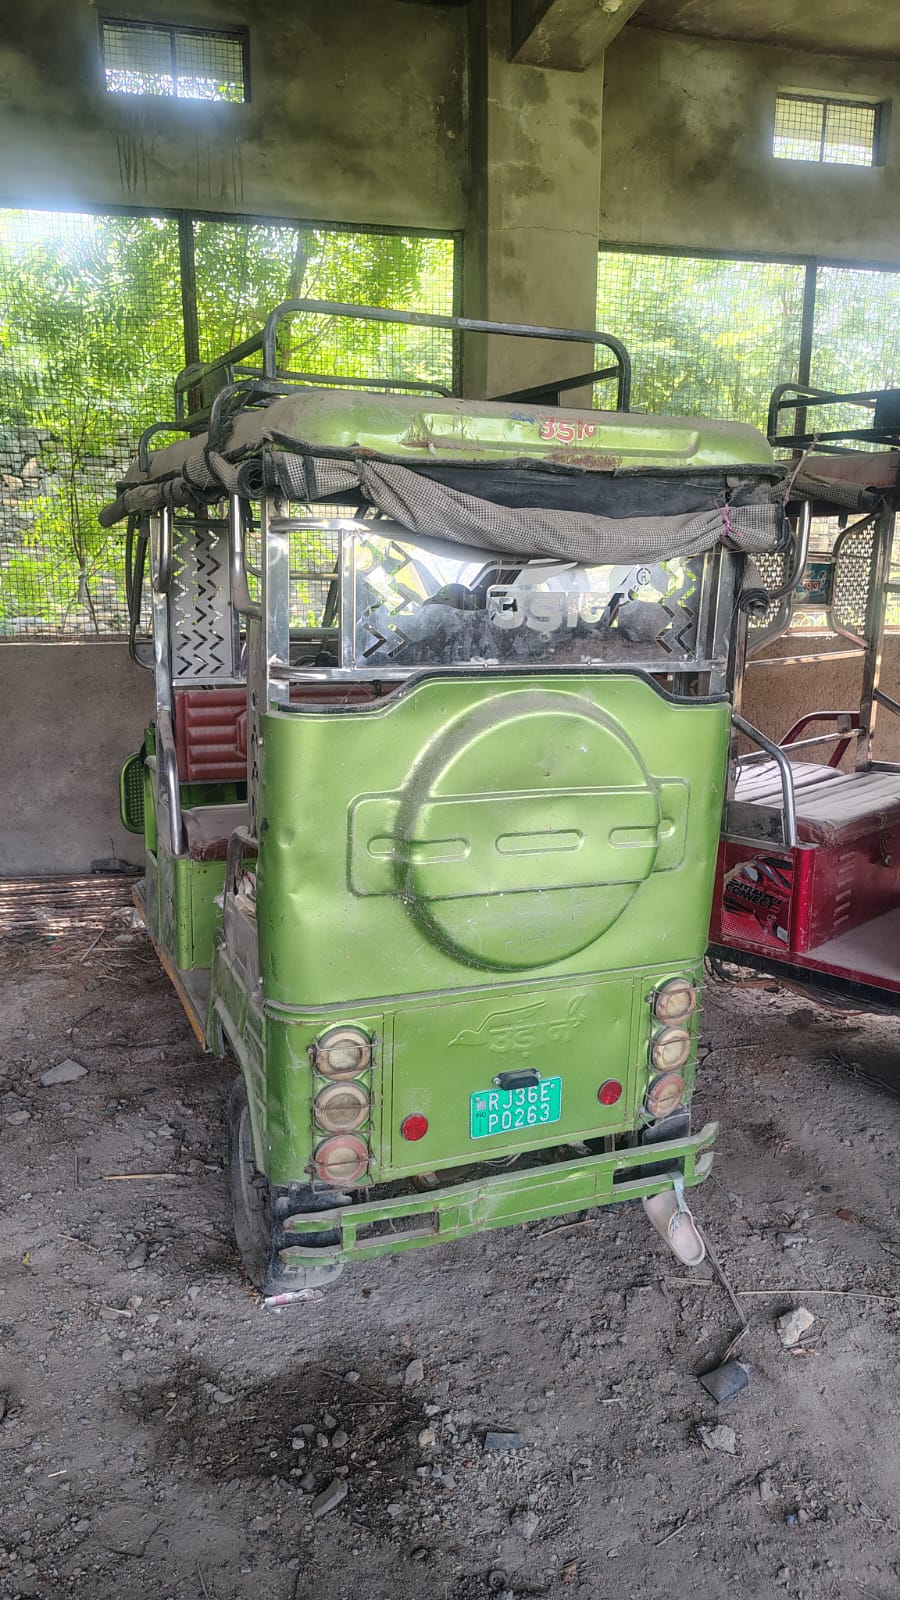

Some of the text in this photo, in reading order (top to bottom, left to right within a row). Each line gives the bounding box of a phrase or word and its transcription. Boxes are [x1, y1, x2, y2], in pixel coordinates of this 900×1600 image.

[726, 883, 774, 909] CONNECT
[729, 877, 784, 905] SMART
[489, 1082, 551, 1112] RJ36E
[488, 1102, 550, 1133] P0263
